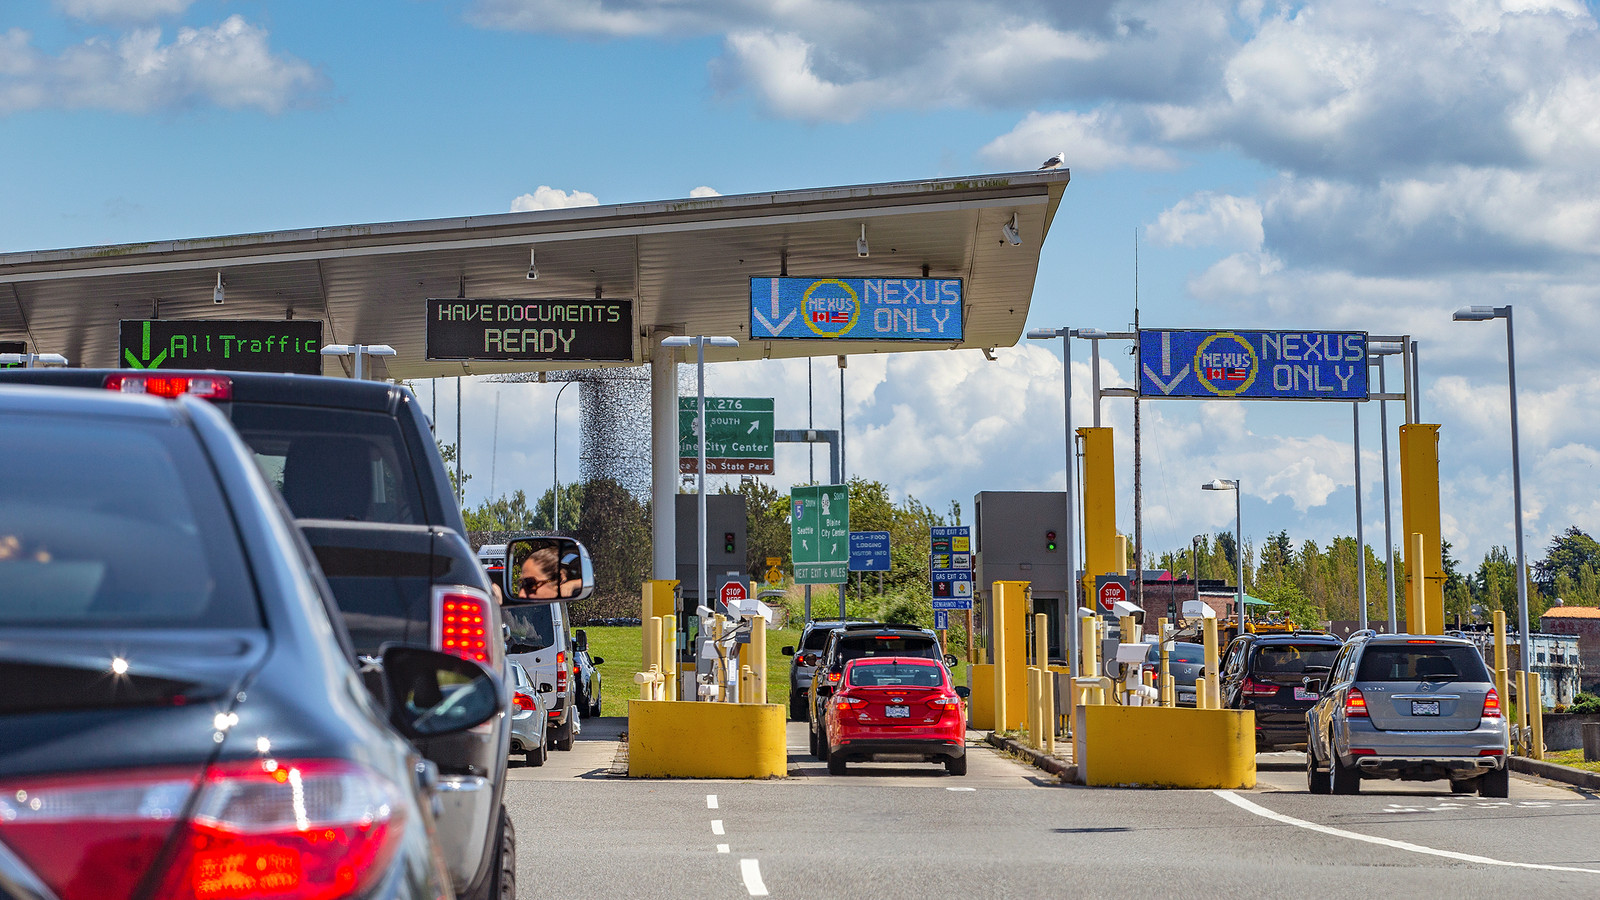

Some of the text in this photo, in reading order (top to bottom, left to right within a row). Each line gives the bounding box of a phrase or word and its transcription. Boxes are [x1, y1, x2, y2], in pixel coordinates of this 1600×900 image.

[864, 279, 959, 305] NEXUS
[808, 298, 854, 311] NEXUS
[438, 304, 620, 322] HAVE DOCUMENTS
[873, 308, 949, 333] ONLY
[170, 335, 316, 358] All Traffic
[484, 328, 576, 352] READY
[1262, 333, 1364, 361] NEXUS
[1202, 353, 1250, 368] NEXUS
[1273, 364, 1354, 391] ONLY
[718, 399, 742, 409] 276
[705, 442, 727, 454] City
[732, 442, 768, 451] Center
[796, 505, 802, 518] 5
[797, 527, 814, 535] Seattle
[821, 528, 846, 538] City Center
[795, 567, 846, 578] NEXT EXIT 6 MILES
[726, 588, 741, 596] STOP
